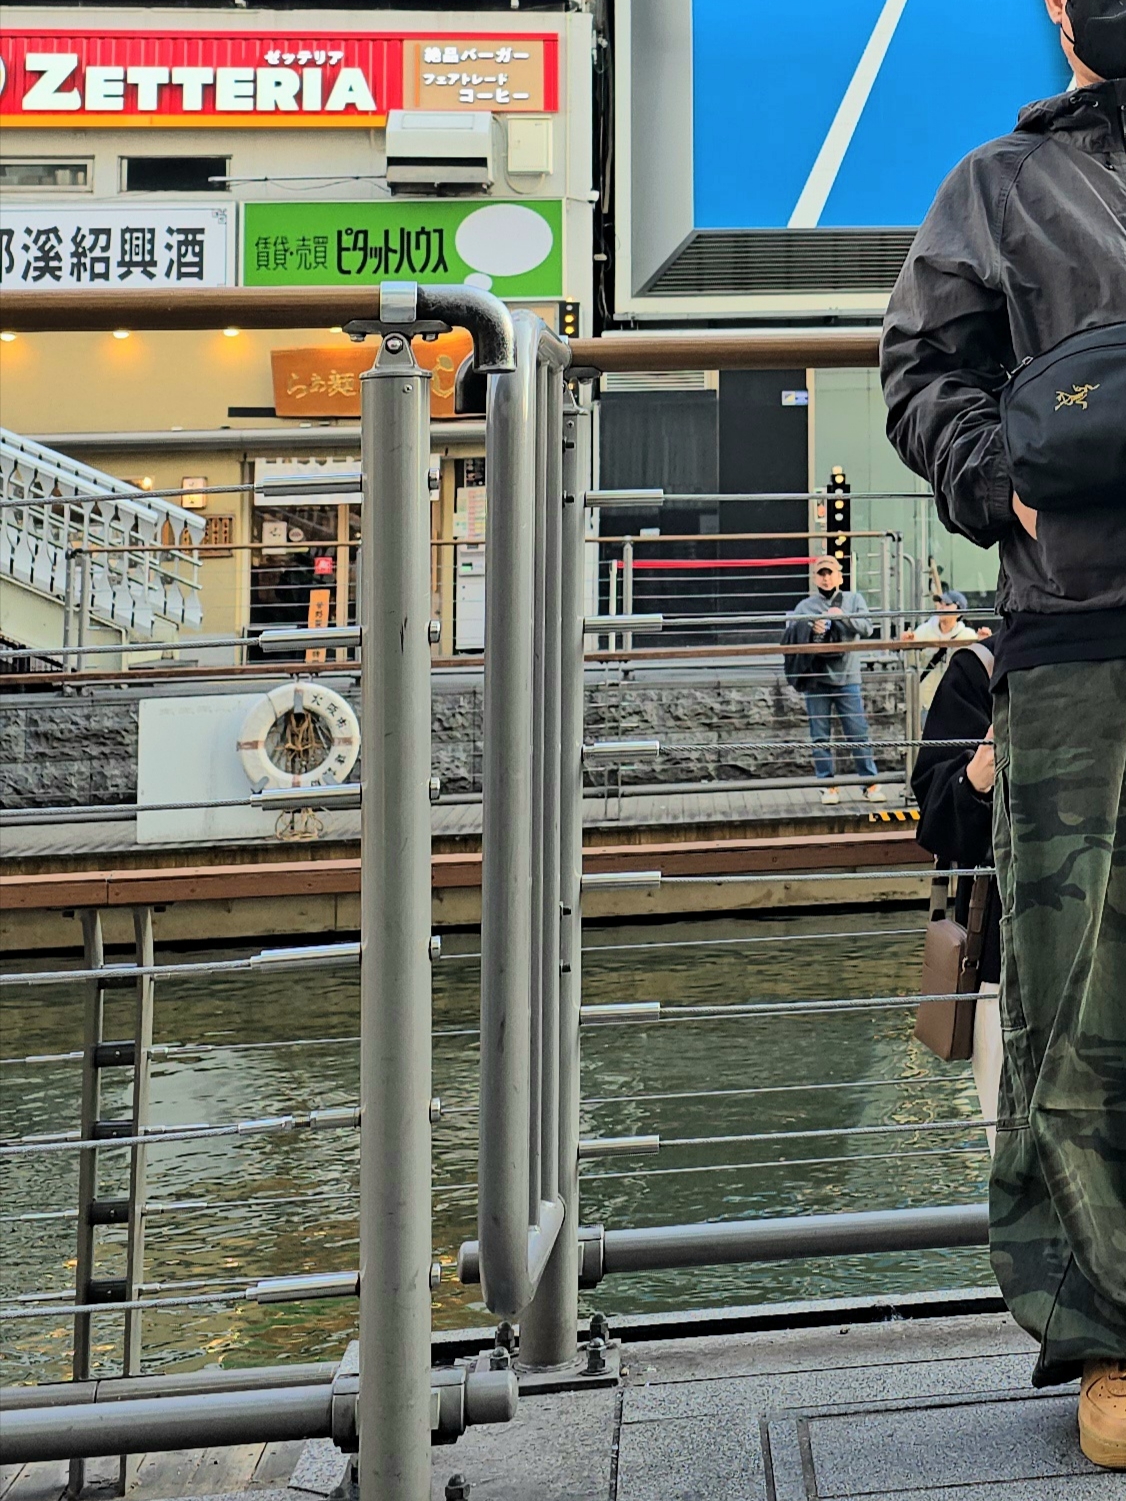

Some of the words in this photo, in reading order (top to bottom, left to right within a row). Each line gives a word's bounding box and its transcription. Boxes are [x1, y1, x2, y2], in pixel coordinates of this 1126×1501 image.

[264, 49, 344, 65] ゼッテリア
[423, 46, 530, 64] 絶品バーガー
[21, 52, 377, 111] ZETTERIA
[422, 72, 509, 86] フェアトレード
[458, 87, 530, 104] コーヒー
[255, 235, 329, 271] 賃貸・売買
[336, 226, 449, 275] ピタットハウス
